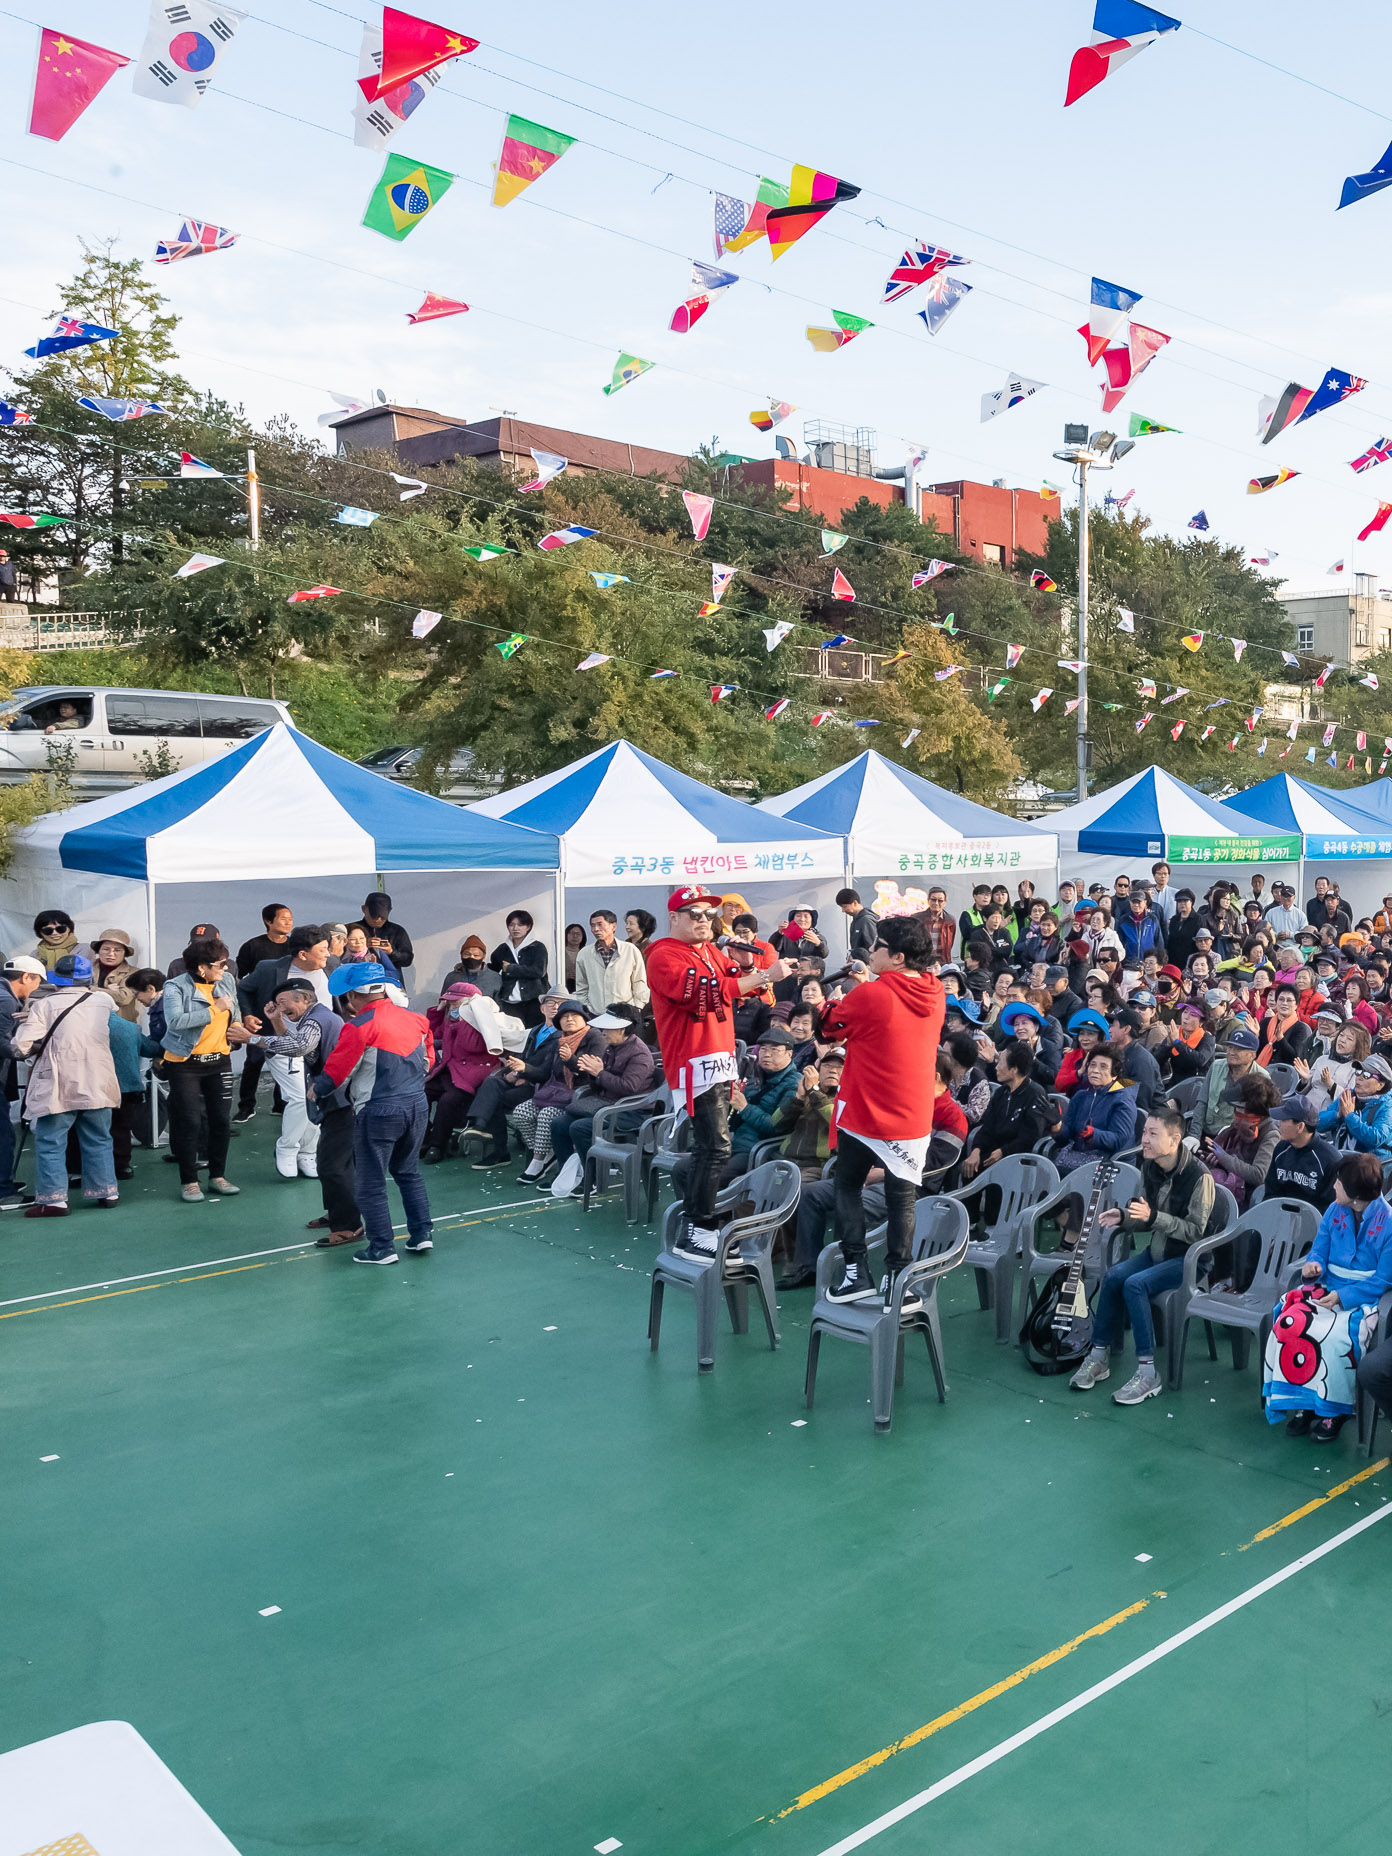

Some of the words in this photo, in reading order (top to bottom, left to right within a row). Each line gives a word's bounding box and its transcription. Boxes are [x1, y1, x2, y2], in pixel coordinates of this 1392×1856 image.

[1182, 847, 1211, 860] 중곡1동
[1213, 848, 1229, 860] 공기
[1323, 841, 1348, 854] 중곡4동
[612, 856, 675, 875] 중곡3동
[683, 855, 748, 874] 냅킨아트
[754, 852, 815, 871] 체험부스
[898, 851, 1021, 871] 중곡종합사회복지관
